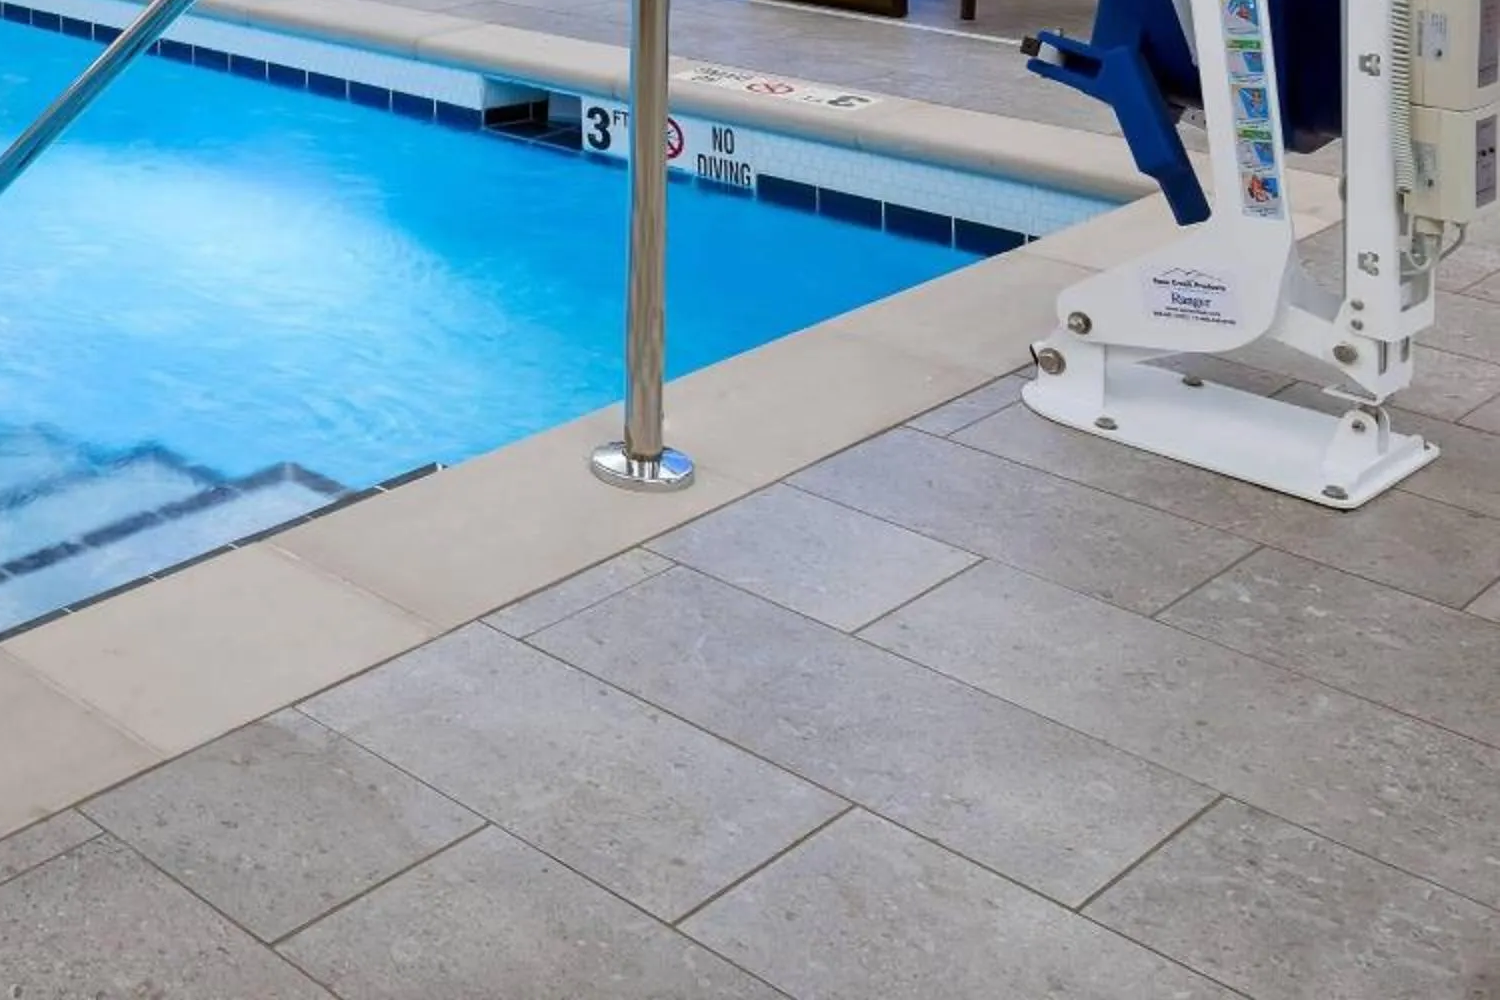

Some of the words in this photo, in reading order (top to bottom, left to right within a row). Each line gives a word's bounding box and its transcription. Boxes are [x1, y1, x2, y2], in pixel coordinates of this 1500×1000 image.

[586, 106, 611, 150] 3
[613, 109, 630, 127] FT
[712, 126, 735, 155] NO
[697, 153, 751, 187] DIVING
